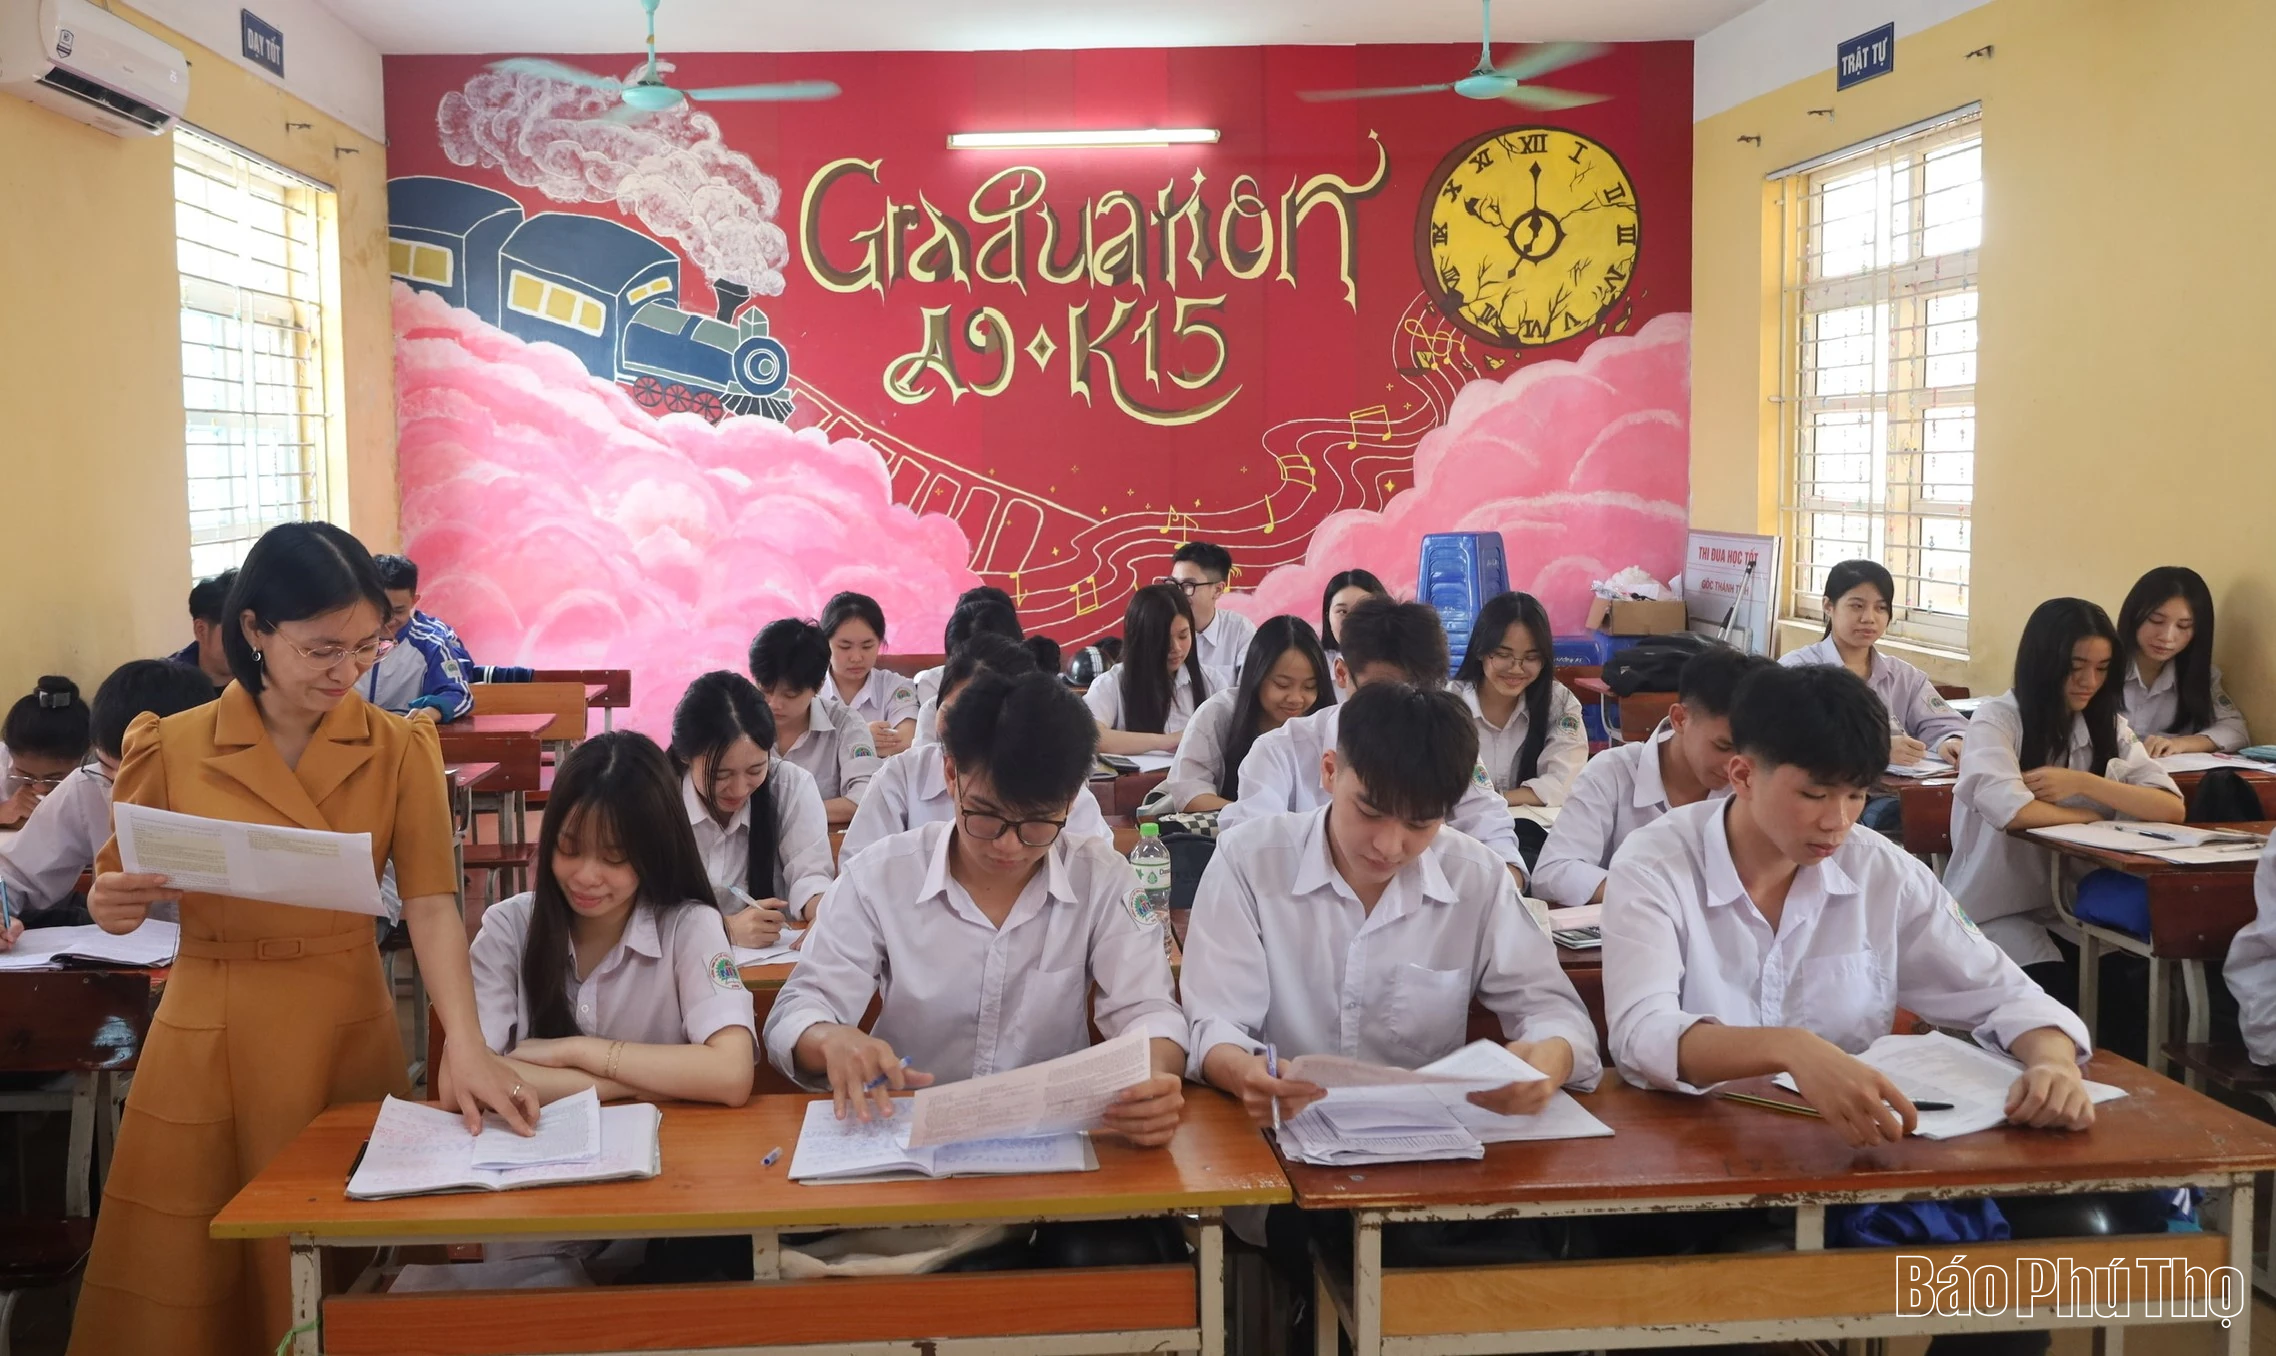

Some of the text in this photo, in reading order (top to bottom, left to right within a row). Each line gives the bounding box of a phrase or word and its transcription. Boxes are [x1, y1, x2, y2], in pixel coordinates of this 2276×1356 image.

[247, 27, 281, 66] DẠY TỐT
[1841, 36, 1888, 76] TRẬT TỰ
[1517, 134, 1548, 155] XII
[1568, 140, 1588, 164] I
[1468, 148, 1493, 174] XI
[1442, 178, 1463, 203] X
[1603, 182, 1626, 203] II
[799, 129, 1390, 314] Graduation
[1616, 223, 1637, 247] III
[1603, 265, 1626, 292] IV
[1522, 320, 1544, 338] VI
[1563, 311, 1581, 332] V
[1698, 546, 1759, 568] THI ĐUA HỌC TỐT
